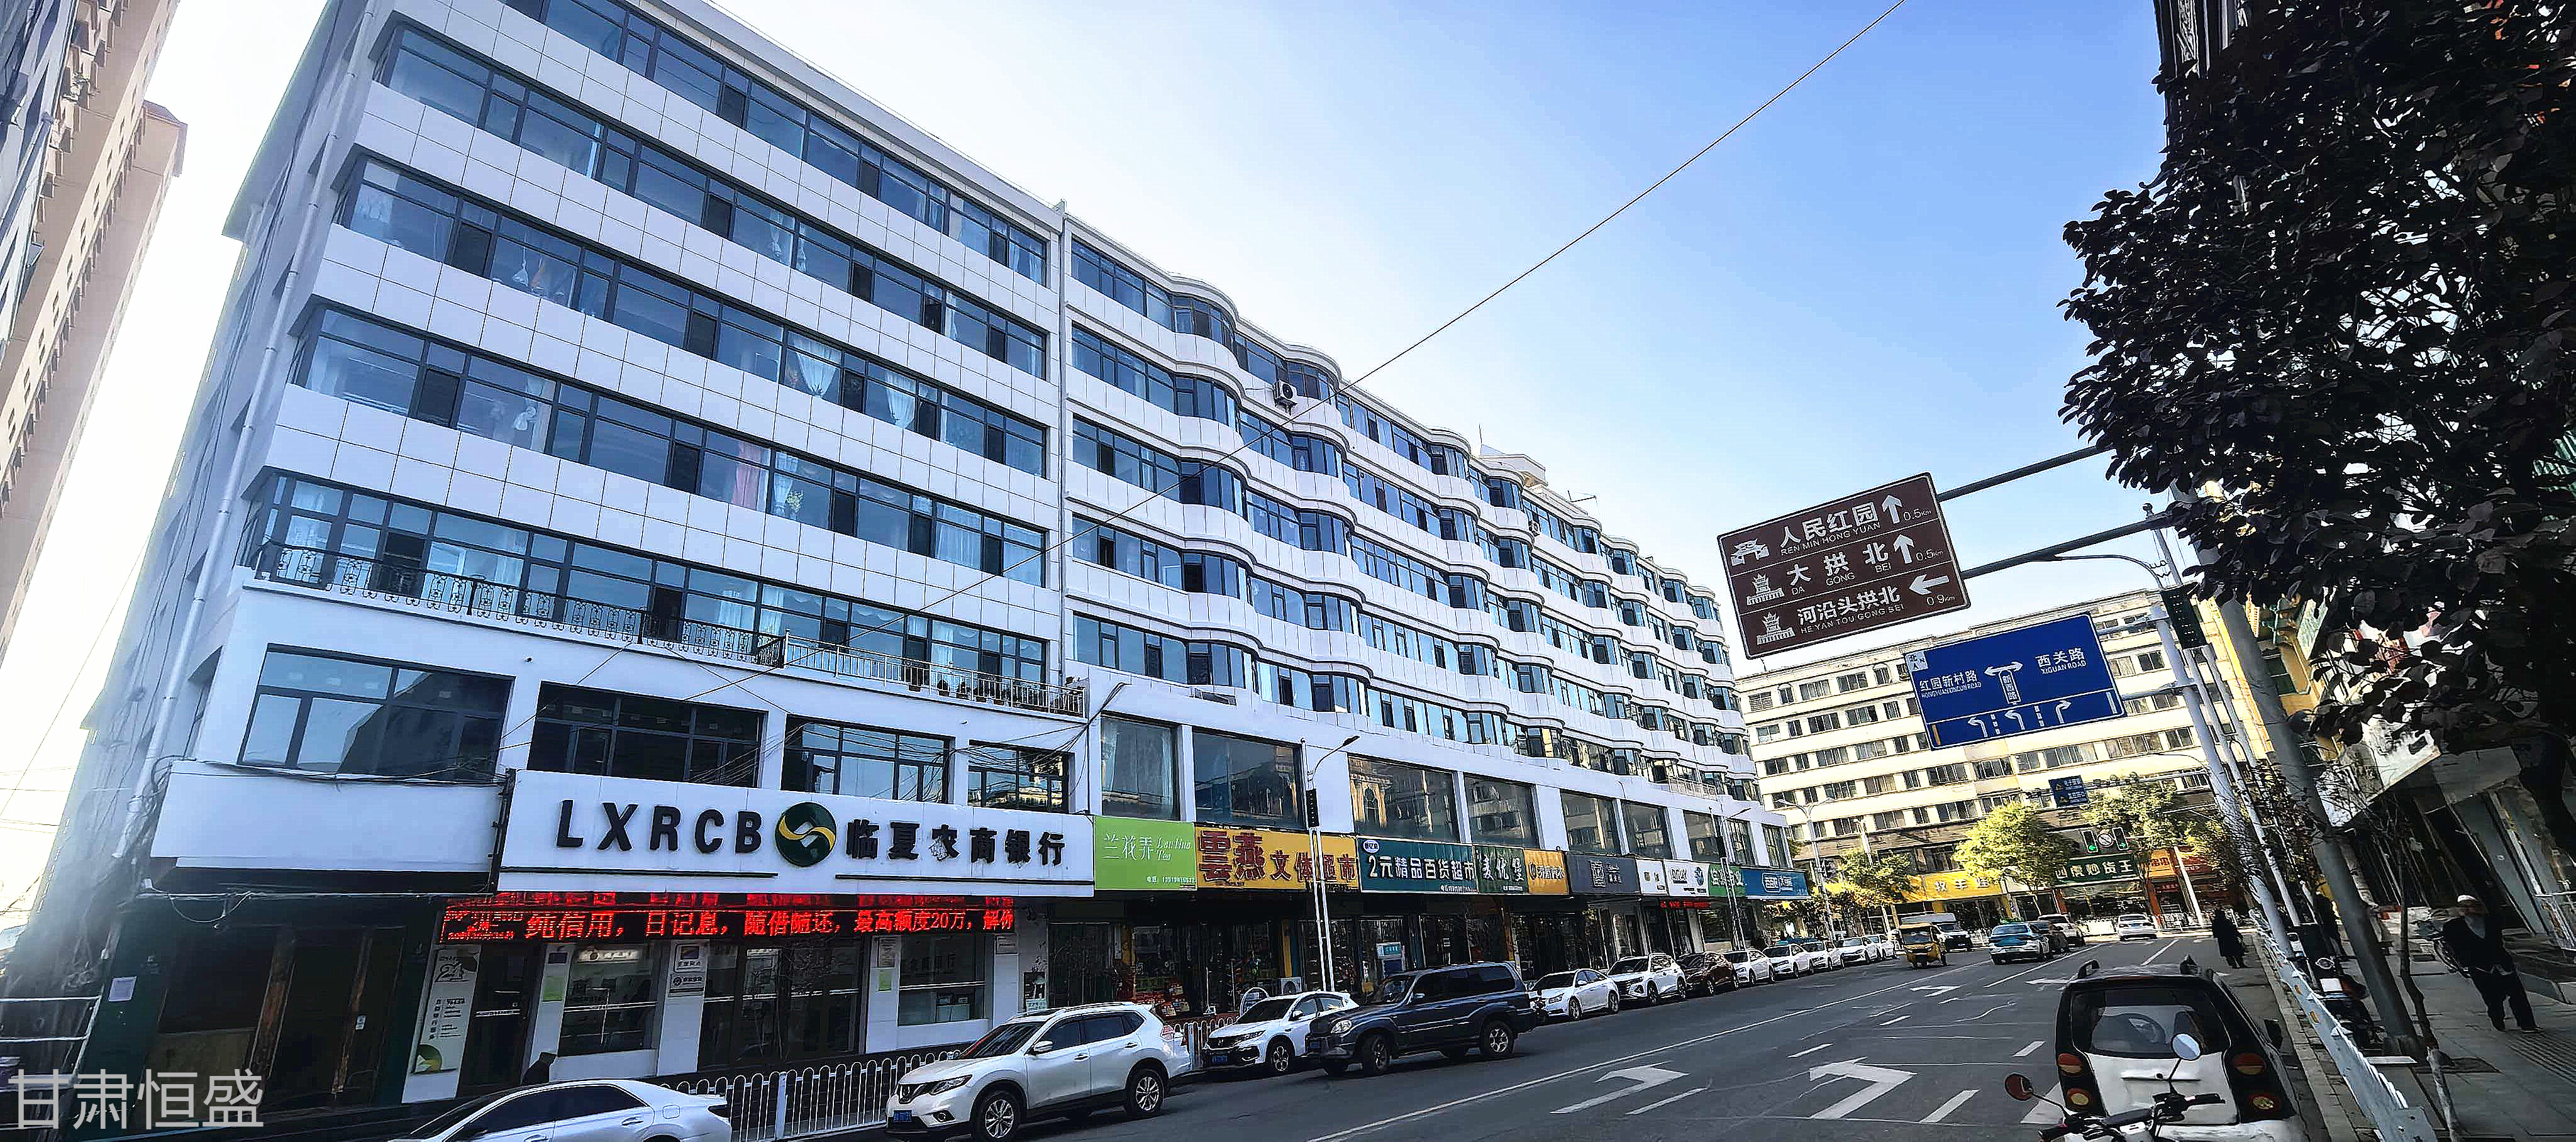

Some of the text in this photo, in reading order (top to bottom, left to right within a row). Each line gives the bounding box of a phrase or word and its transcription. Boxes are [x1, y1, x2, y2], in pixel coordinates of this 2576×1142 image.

[1780, 502, 1879, 548] 人民红园
[1780, 522, 1880, 556] REN MIN HONG YUAN
[1787, 542, 1889, 586] 大拱北
[1791, 563, 1891, 595] DA GONG BEI
[1797, 586, 1900, 625] 河沿头拱北
[1815, 621, 1833, 631] YAN
[1836, 616, 1855, 625] TOU
[1857, 609, 1885, 620] GONG
[2035, 648, 2085, 667] 西关路
[2041, 660, 2086, 674] XIGUAN ROAD
[1919, 670, 1977, 691] 红园新村路
[557, 799, 762, 853] LXRCB
[846, 819, 1065, 866] 临夏农商银行
[1368, 855, 1475, 880] 2元精品百货超市
